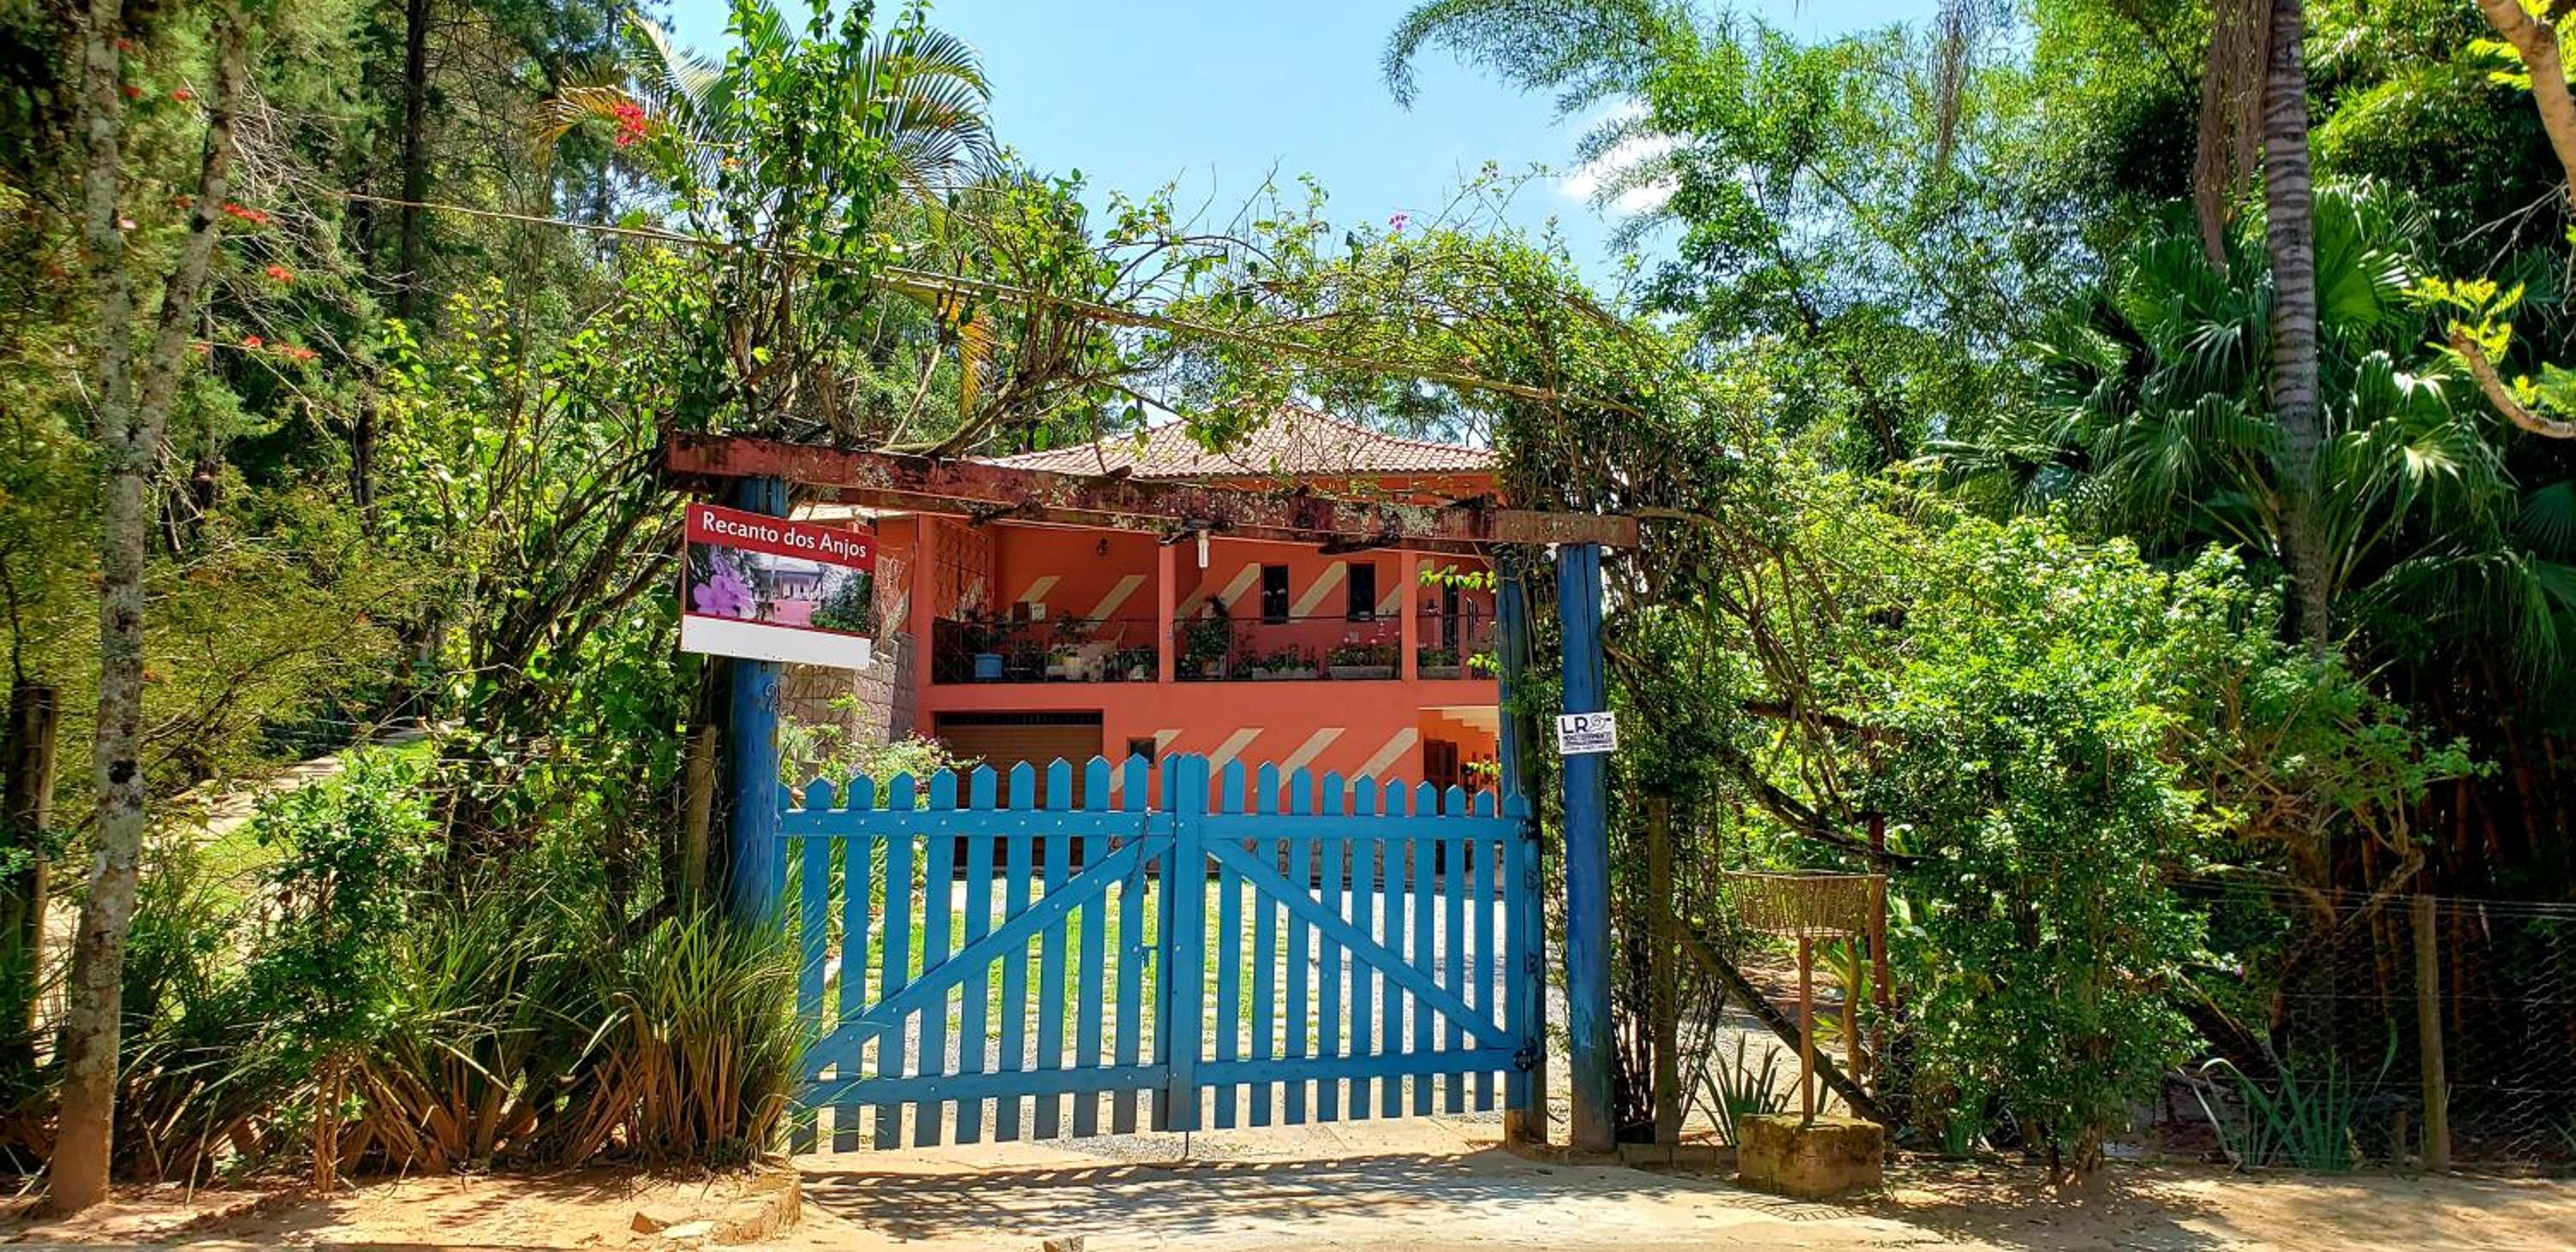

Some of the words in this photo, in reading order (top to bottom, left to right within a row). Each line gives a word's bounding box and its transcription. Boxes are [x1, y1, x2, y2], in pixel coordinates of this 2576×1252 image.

[702, 511, 779, 542] Recanto
[783, 528, 815, 549] dos
[819, 533, 866, 560] Anjos
[1561, 716, 1589, 733] LR
